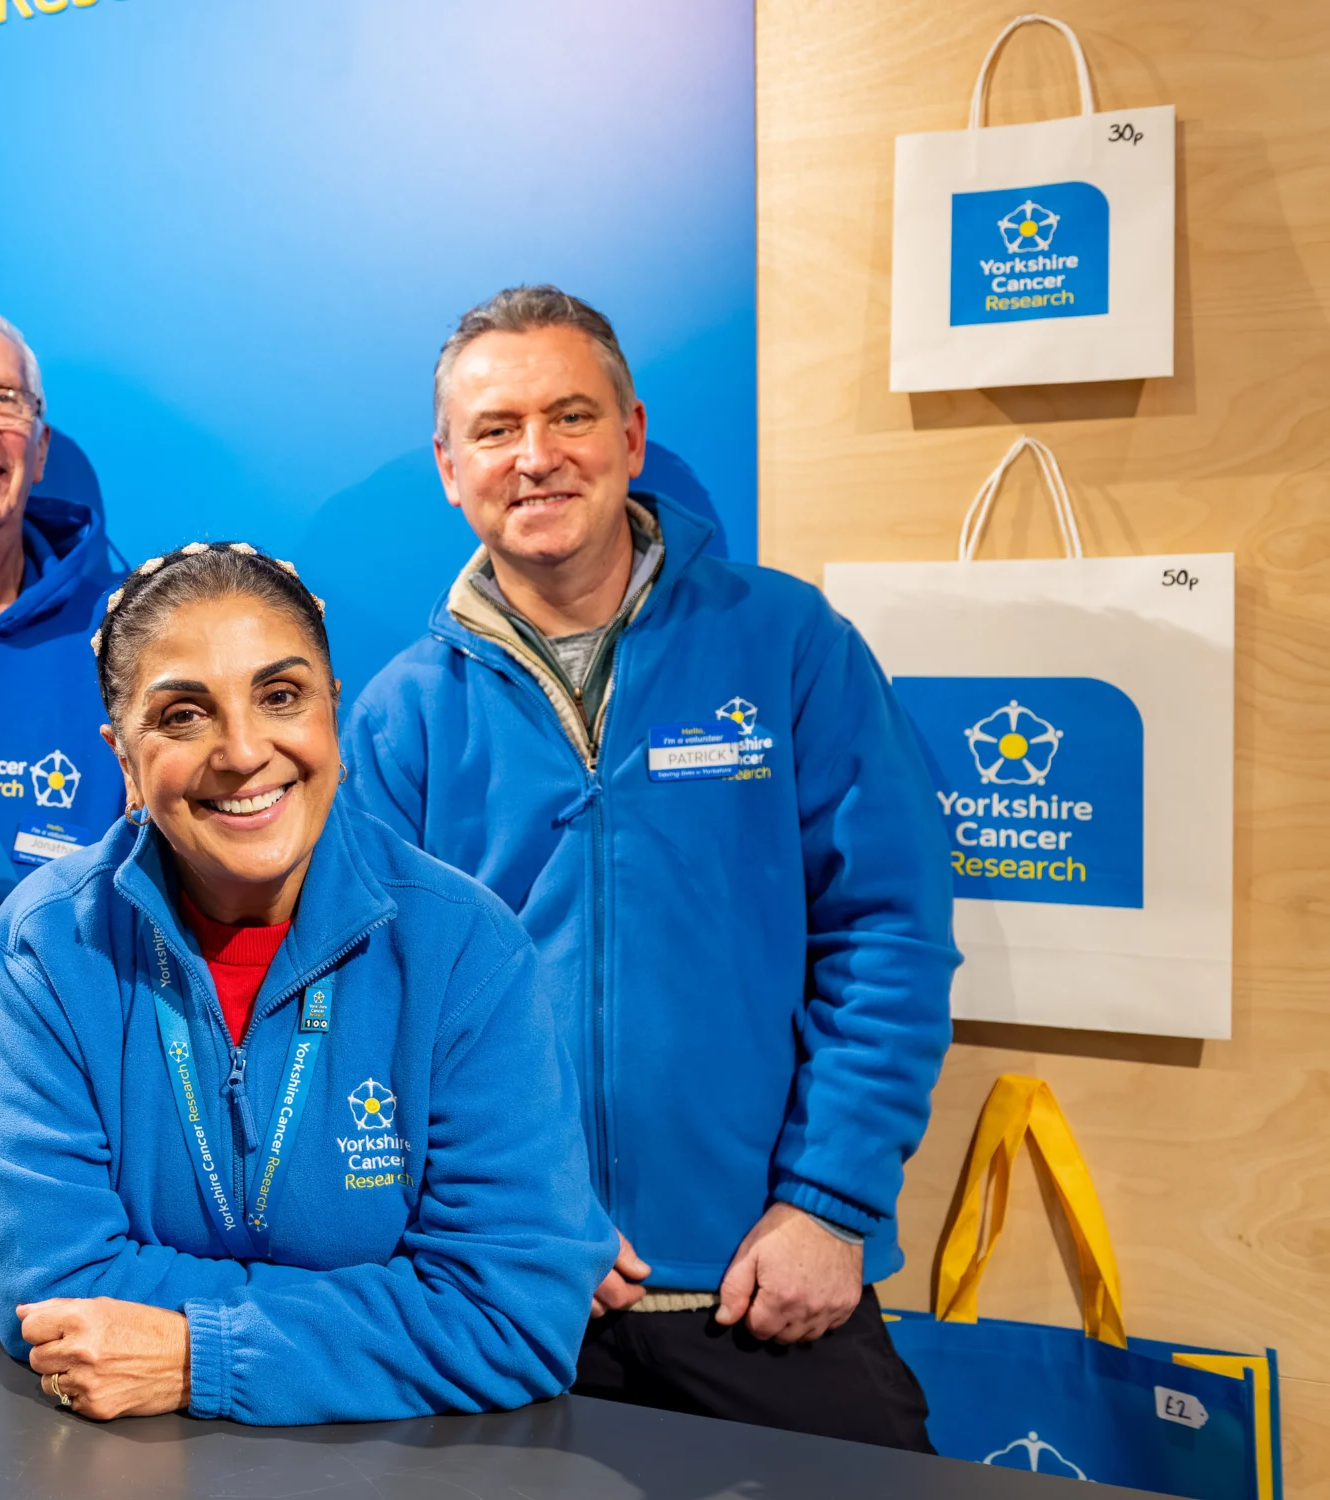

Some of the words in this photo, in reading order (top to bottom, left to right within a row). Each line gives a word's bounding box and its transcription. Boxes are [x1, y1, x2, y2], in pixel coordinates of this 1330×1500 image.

[1108, 123, 1144, 146] 30p
[979, 253, 1079, 276] Yorkshire
[991, 274, 1066, 293] Cancer
[985, 290, 1074, 311] Research
[1161, 569, 1199, 591] 50p
[685, 734, 724, 744] volunteer
[668, 748, 728, 766] PATRICK
[936, 790, 1093, 821] Yorkshire
[955, 821, 1073, 851] Cancer
[951, 850, 1086, 882] Research
[152, 927, 172, 988] Yorkshire
[306, 1019, 328, 1028] 100
[284, 1042, 311, 1105] Yorkshire
[177, 1063, 201, 1123] Research
[271, 1106, 294, 1156] Cancer
[193, 1124, 215, 1172] Cancer
[336, 1133, 412, 1153] Yorkshire
[349, 1154, 405, 1170] Cancer
[255, 1155, 280, 1212] Research
[345, 1173, 414, 1190] Research
[209, 1173, 236, 1232] Yorkshire
